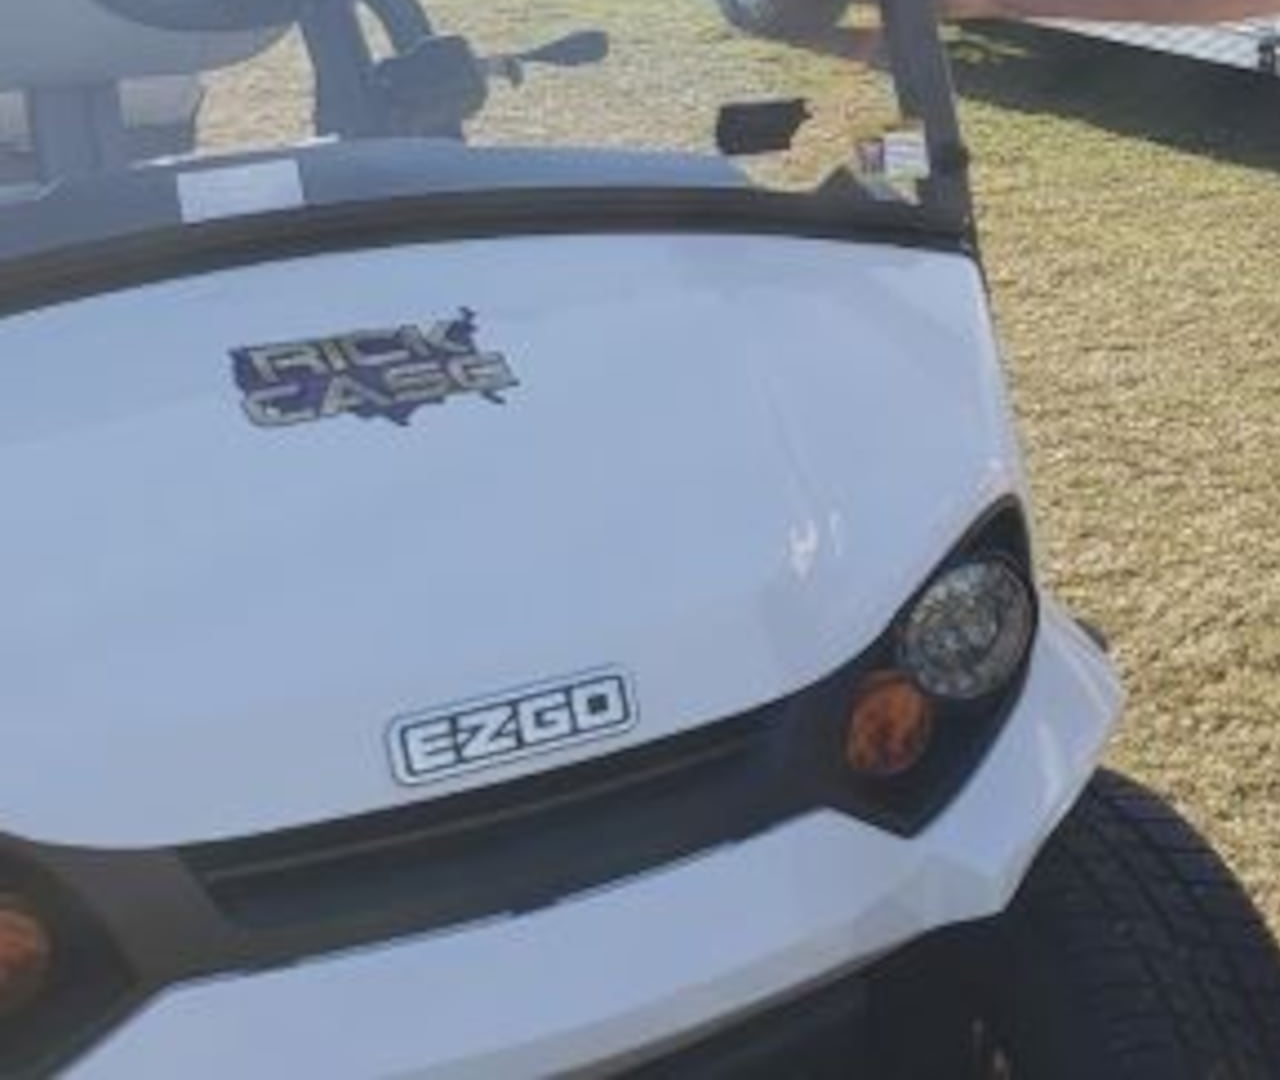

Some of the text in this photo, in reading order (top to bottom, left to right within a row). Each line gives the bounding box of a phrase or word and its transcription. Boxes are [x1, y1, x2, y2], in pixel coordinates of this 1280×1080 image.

[243, 352, 517, 428] CASE
[249, 320, 472, 385] RICK
[402, 677, 628, 775] EZGO
